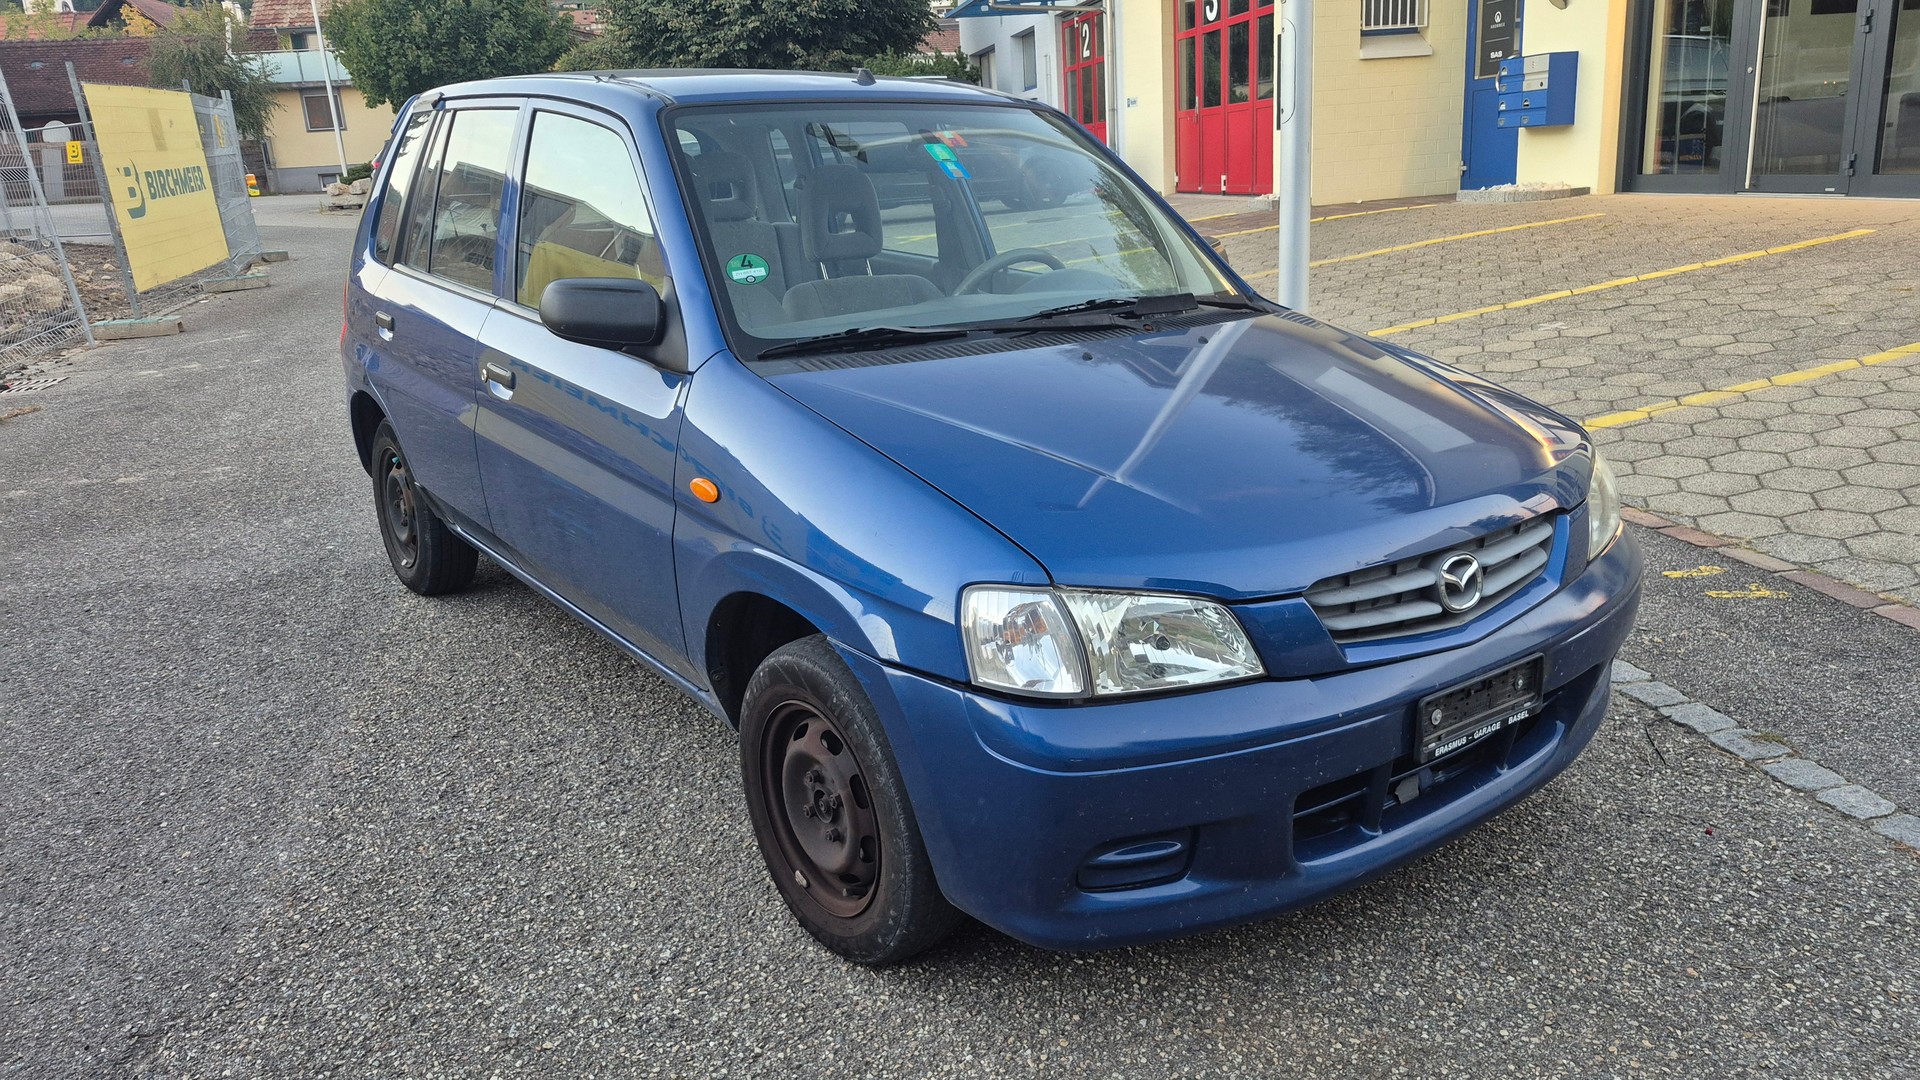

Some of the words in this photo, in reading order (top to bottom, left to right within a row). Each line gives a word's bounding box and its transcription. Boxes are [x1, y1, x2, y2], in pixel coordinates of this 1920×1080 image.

[1082, 23, 1090, 58] 2
[1490, 50, 1502, 58] SAS
[144, 166, 207, 200] BIRCHMEIER
[741, 255, 753, 268] 4
[1434, 736, 1467, 757] ERASMUS
[1473, 721, 1501, 739] GARAGE
[1508, 710, 1529, 725] BASEL
